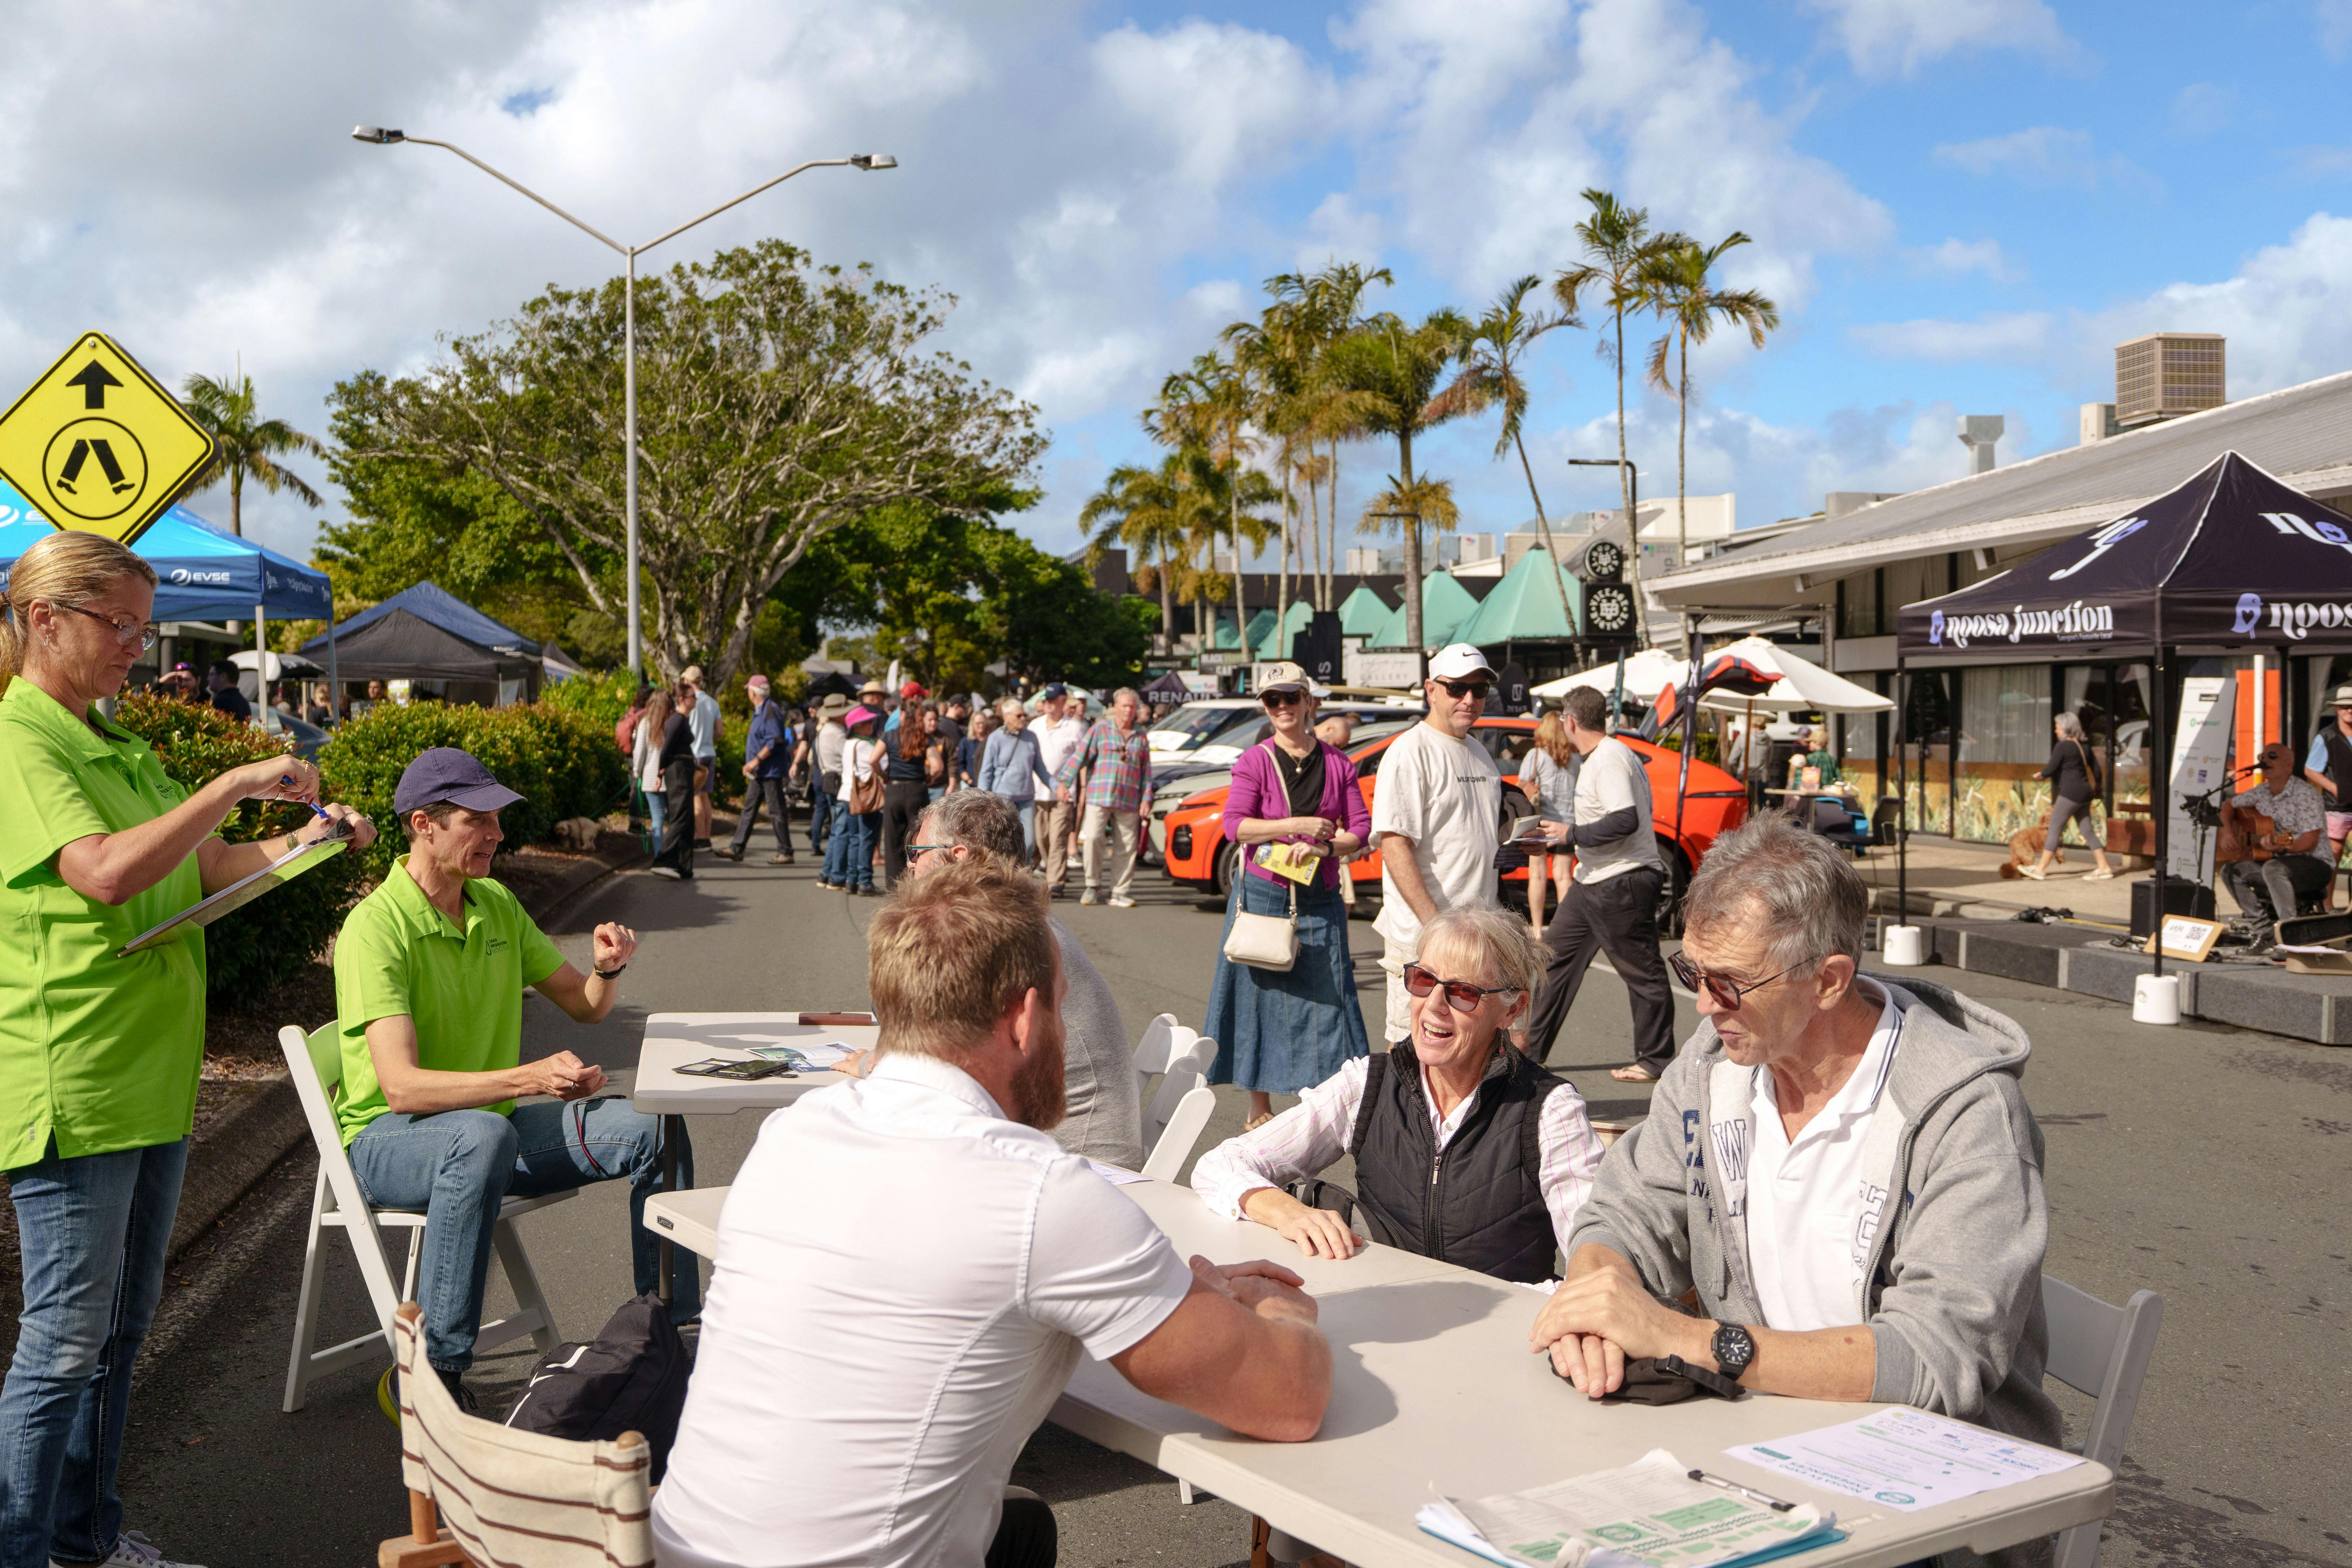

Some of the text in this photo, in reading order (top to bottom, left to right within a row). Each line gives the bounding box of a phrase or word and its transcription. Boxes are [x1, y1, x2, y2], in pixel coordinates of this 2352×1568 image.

[193, 572, 230, 581] EVSE
[1589, 588, 1630, 606] VILLAGE
[1589, 612, 1630, 631] BICYCLE
[1945, 600, 2114, 649] noosa junction
[1148, 691, 1224, 703] RENAULT
[491, 944, 510, 954] NOOSA
[1779, 1463, 1808, 1475] EXPO
[1789, 1461, 1871, 1490] EXPERIENCES
[1825, 1478, 1862, 1494] NOOSA
